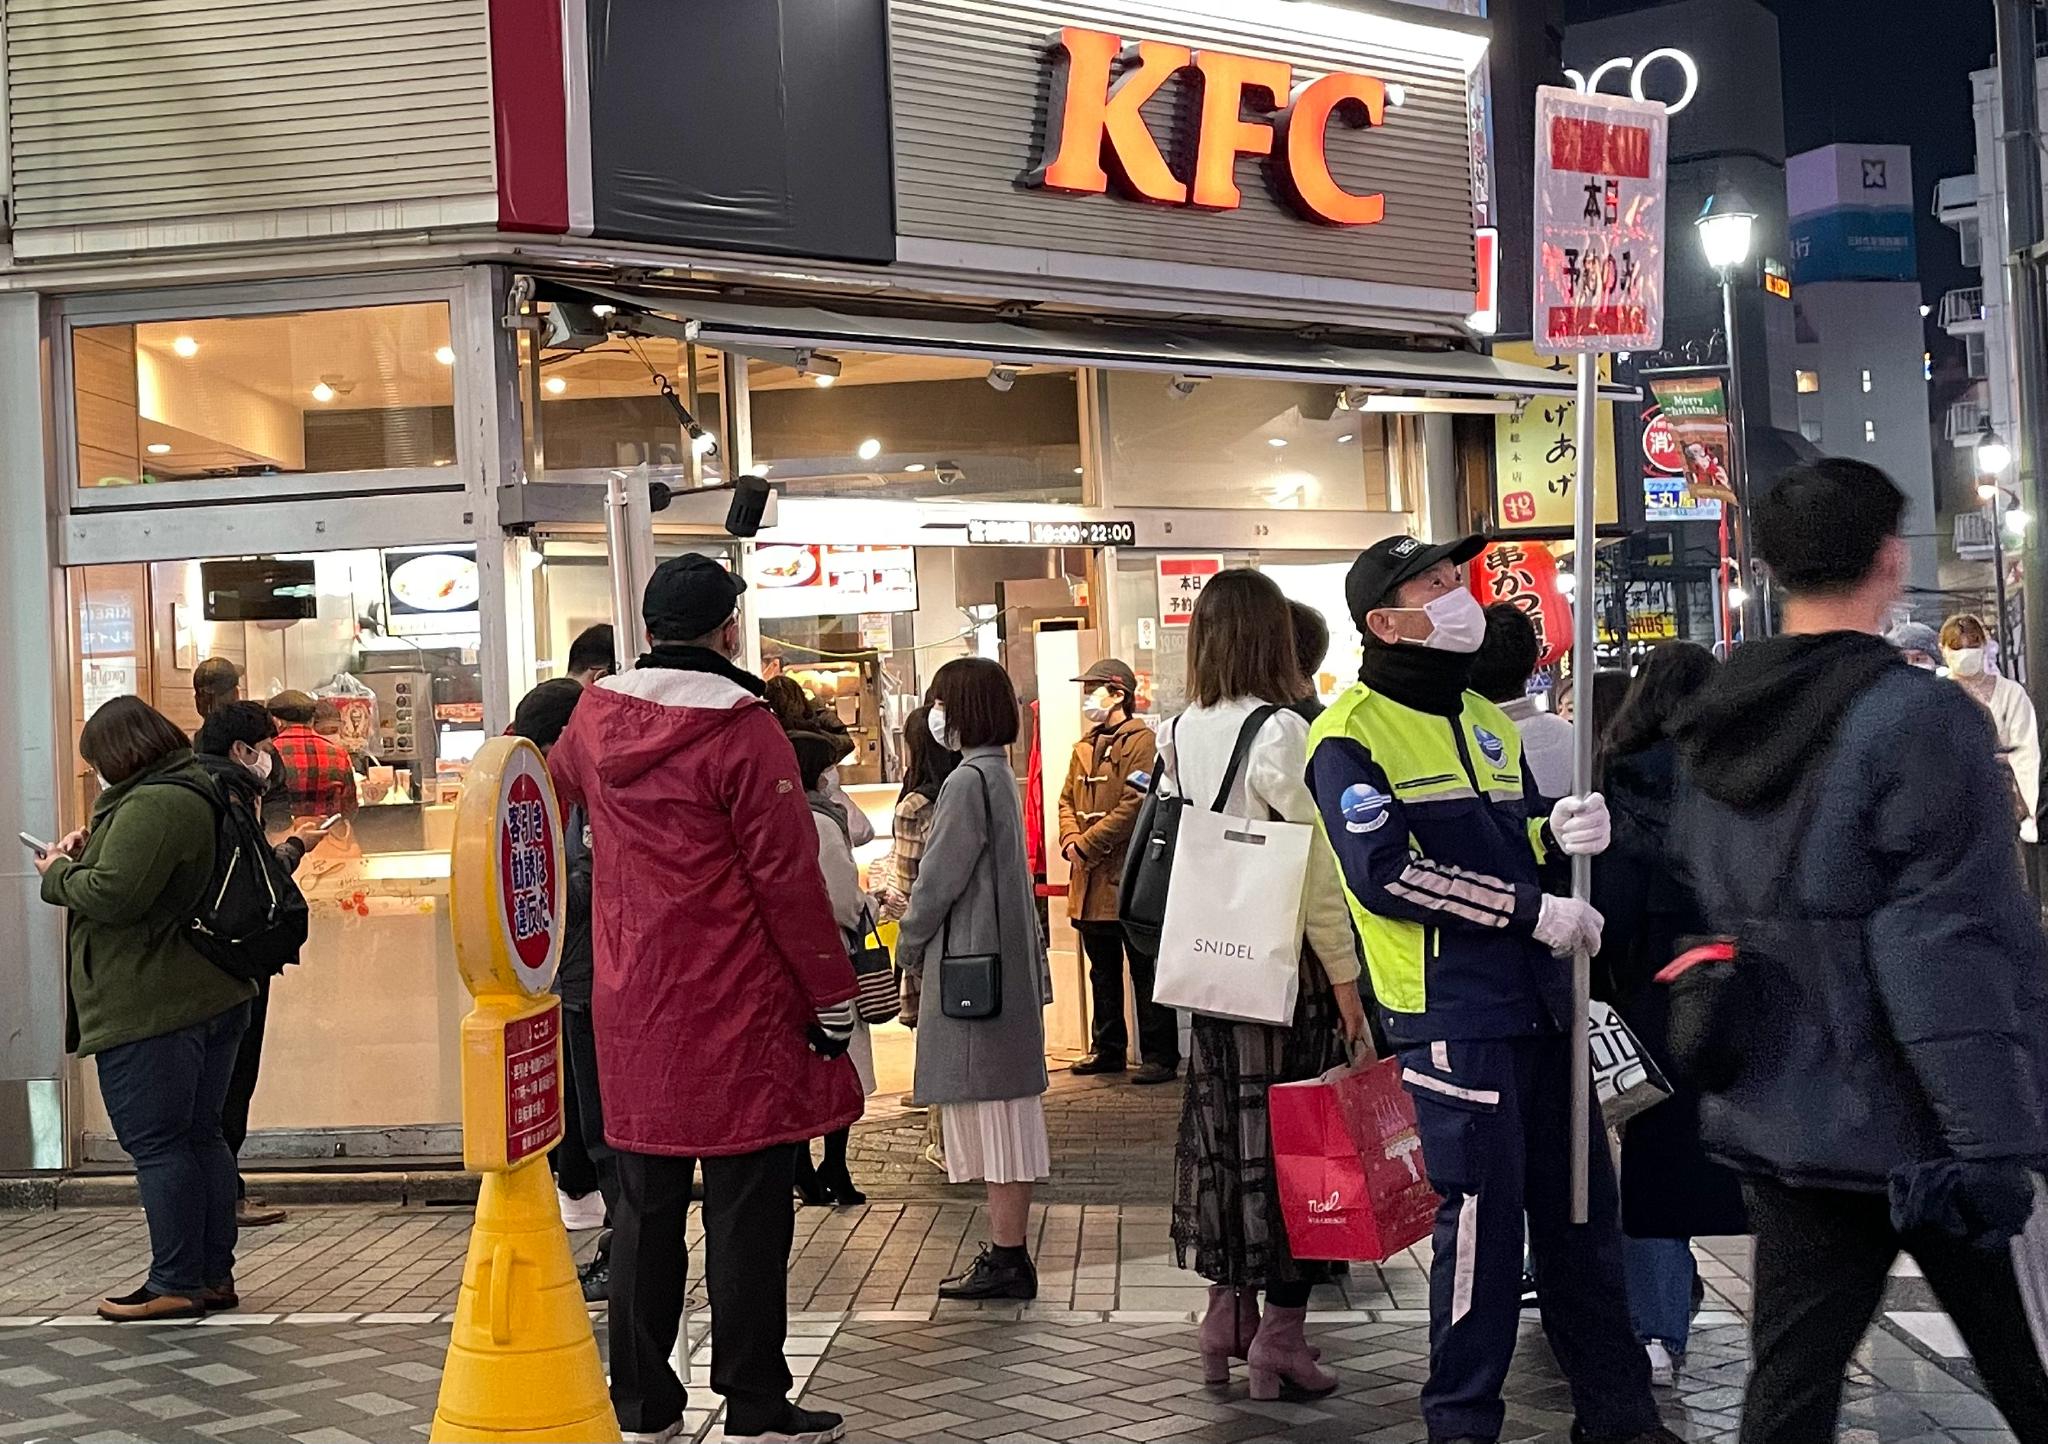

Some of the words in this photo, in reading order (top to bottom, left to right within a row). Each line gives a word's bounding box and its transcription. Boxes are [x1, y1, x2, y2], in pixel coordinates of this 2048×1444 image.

[1045, 27, 1386, 225] KFC
[1583, 176, 1619, 227] 本日
[1563, 248, 1640, 298] 予約のみ
[1673, 395, 1703, 406] Merry
[1090, 523, 1132, 543] 22:00
[1180, 575, 1202, 591] 本日
[508, 802, 543, 844] 客引き
[512, 849, 548, 890] 勧誘は
[515, 893, 550, 937] 違反だ
[1193, 938, 1254, 960] SNIDEL
